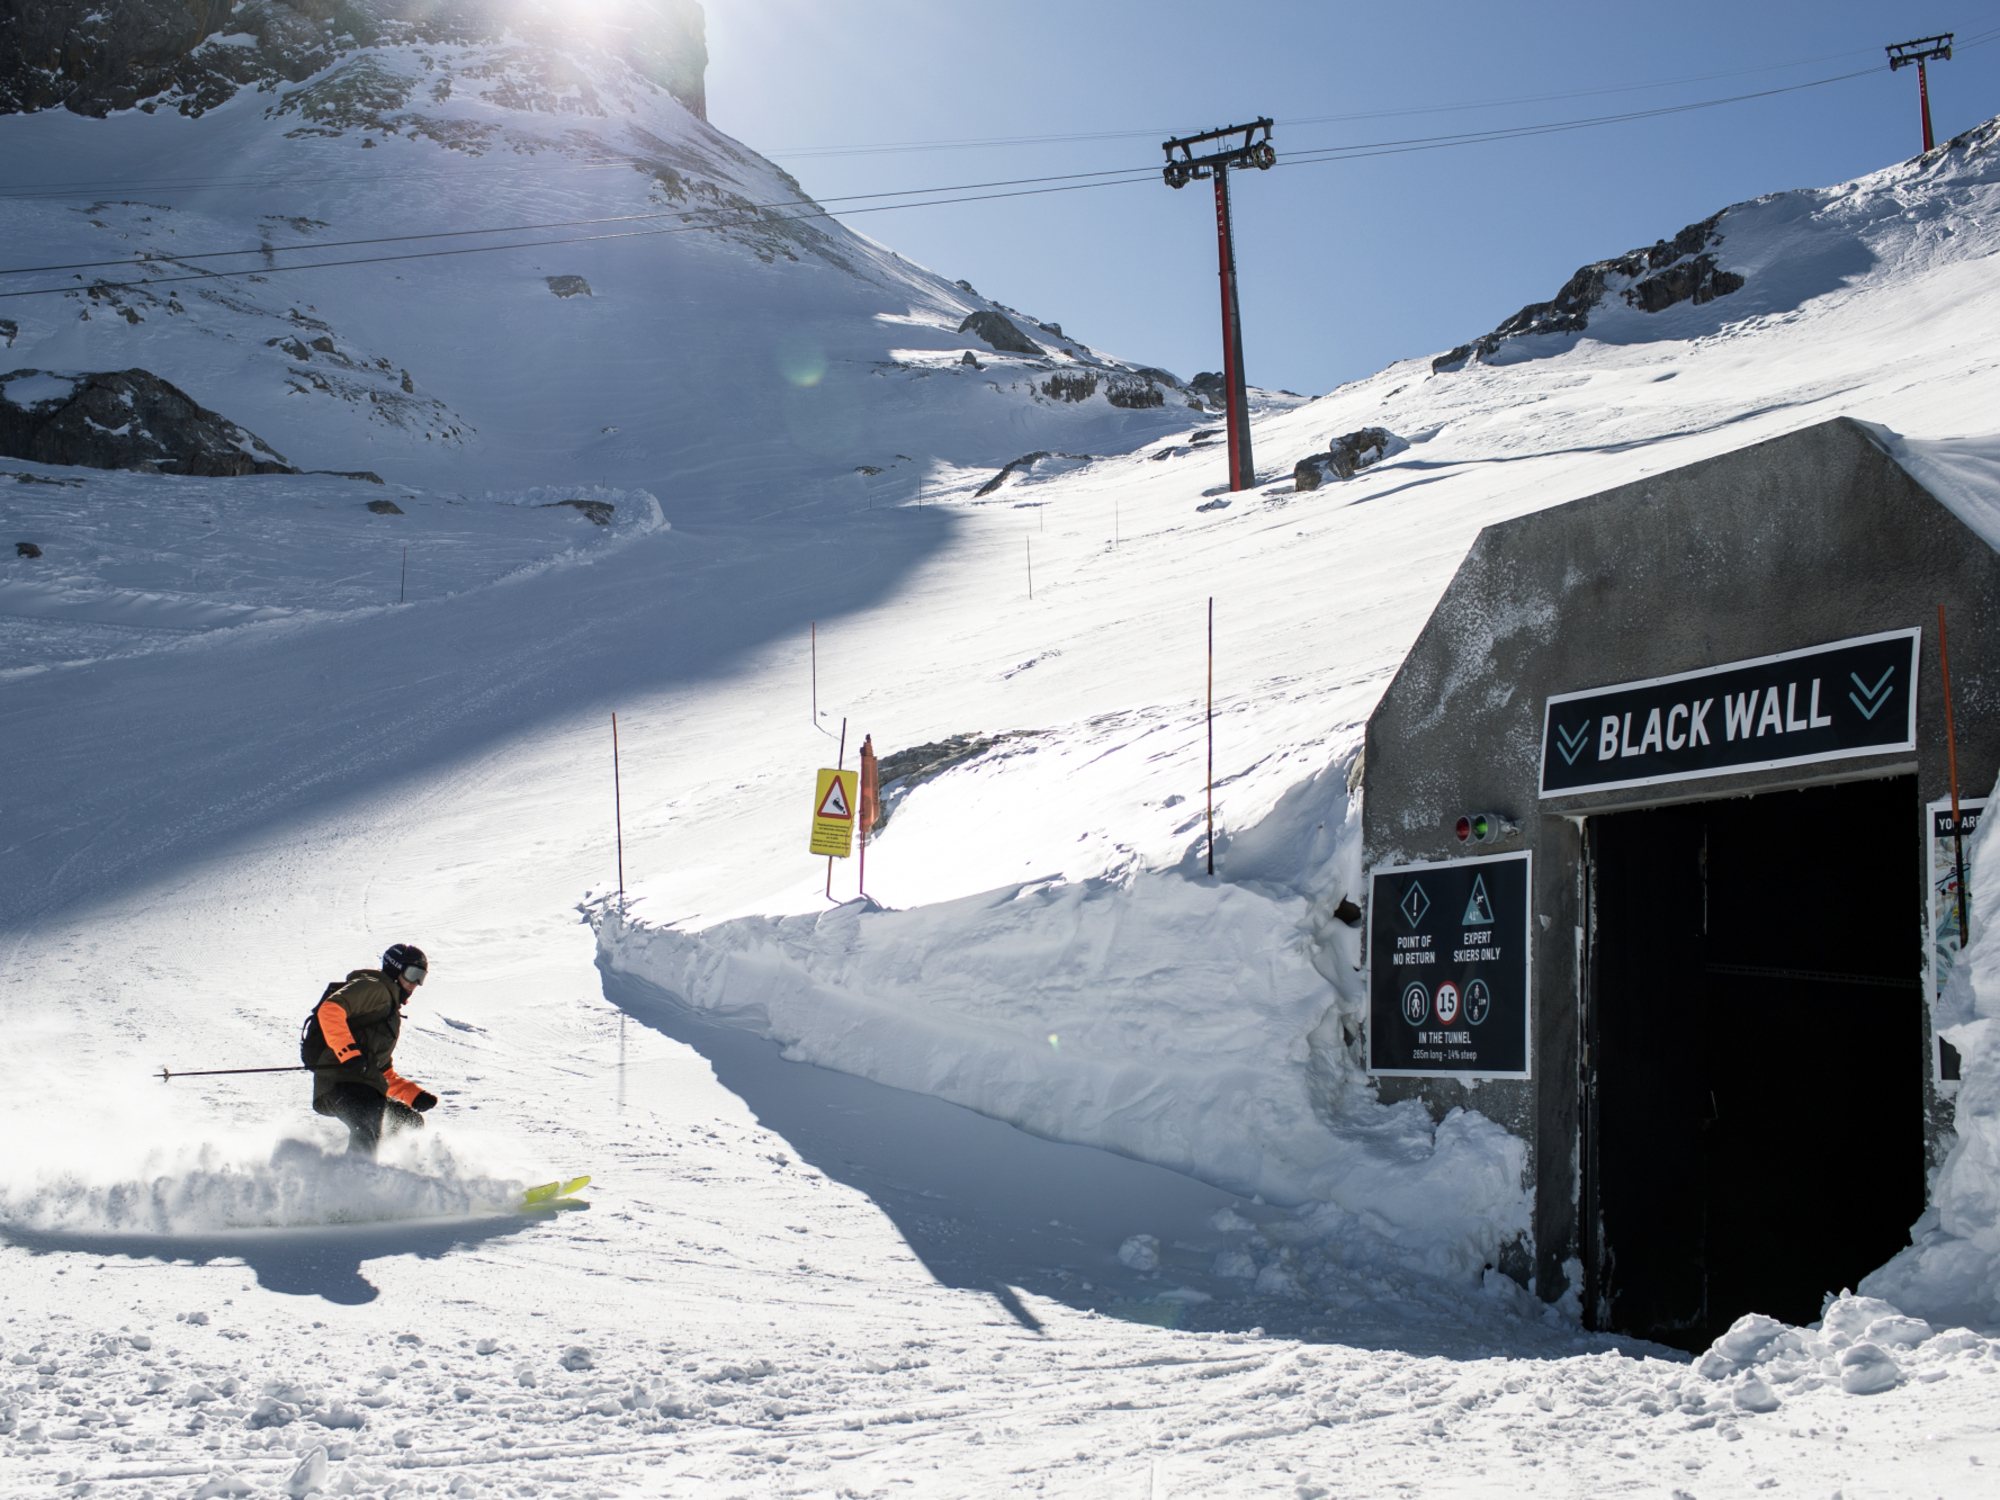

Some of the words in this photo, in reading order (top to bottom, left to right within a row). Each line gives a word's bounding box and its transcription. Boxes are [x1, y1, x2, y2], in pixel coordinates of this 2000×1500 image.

[1216, 190, 1224, 236] PRADA
[1598, 698, 1714, 761] BLACK
[1725, 678, 1832, 742] WALL
[1939, 818, 1954, 830] YO
[1397, 936, 1420, 949] POINT
[1421, 935, 1432, 948] OF
[1464, 931, 1492, 945] EXPERT
[1393, 953, 1404, 965] NO
[1405, 951, 1436, 965] RETURN
[1453, 949, 1480, 962] SKIERS
[1481, 947, 1501, 961] ONLY
[1440, 992, 1455, 1013] 15
[1418, 1031, 1427, 1044] IN
[1428, 1031, 1443, 1044] THE
[1444, 1031, 1472, 1044] TUNNEL
[1412, 1049, 1429, 1059] 265m
[1430, 1049, 1443, 1062] long
[1447, 1050, 1460, 1060] 14%
[1460, 1050, 1478, 1062] steep
